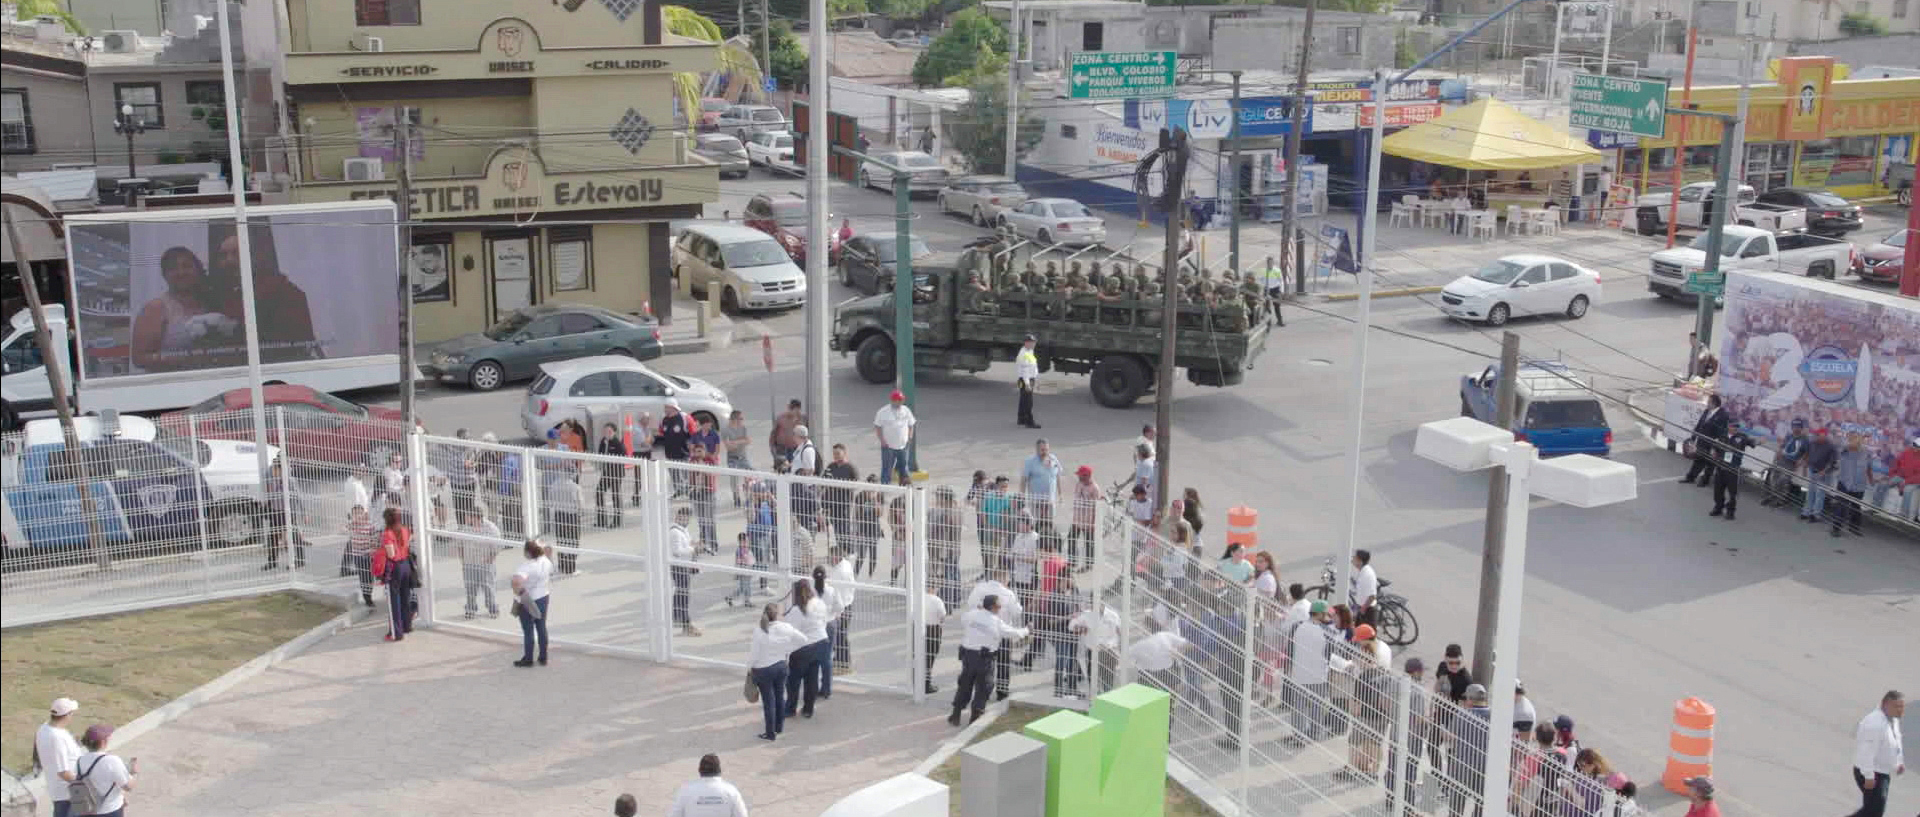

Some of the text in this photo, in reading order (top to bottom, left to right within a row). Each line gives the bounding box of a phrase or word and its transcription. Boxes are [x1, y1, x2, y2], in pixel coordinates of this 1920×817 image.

[592, 58, 661, 70] CALIDAD
[1073, 53, 1150, 65] ZONA CENTRO
[349, 65, 430, 77] SERVICIO
[1089, 66, 1166, 76] BLVD. COLOSIO
[1089, 75, 1166, 86] PARQUE VIVEROS
[1575, 75, 1641, 93] ZONA CENTRO
[1314, 91, 1361, 102] MEJOR
[1572, 115, 1631, 132] CRUZ ROJA
[555, 178, 664, 206] Estevaly
